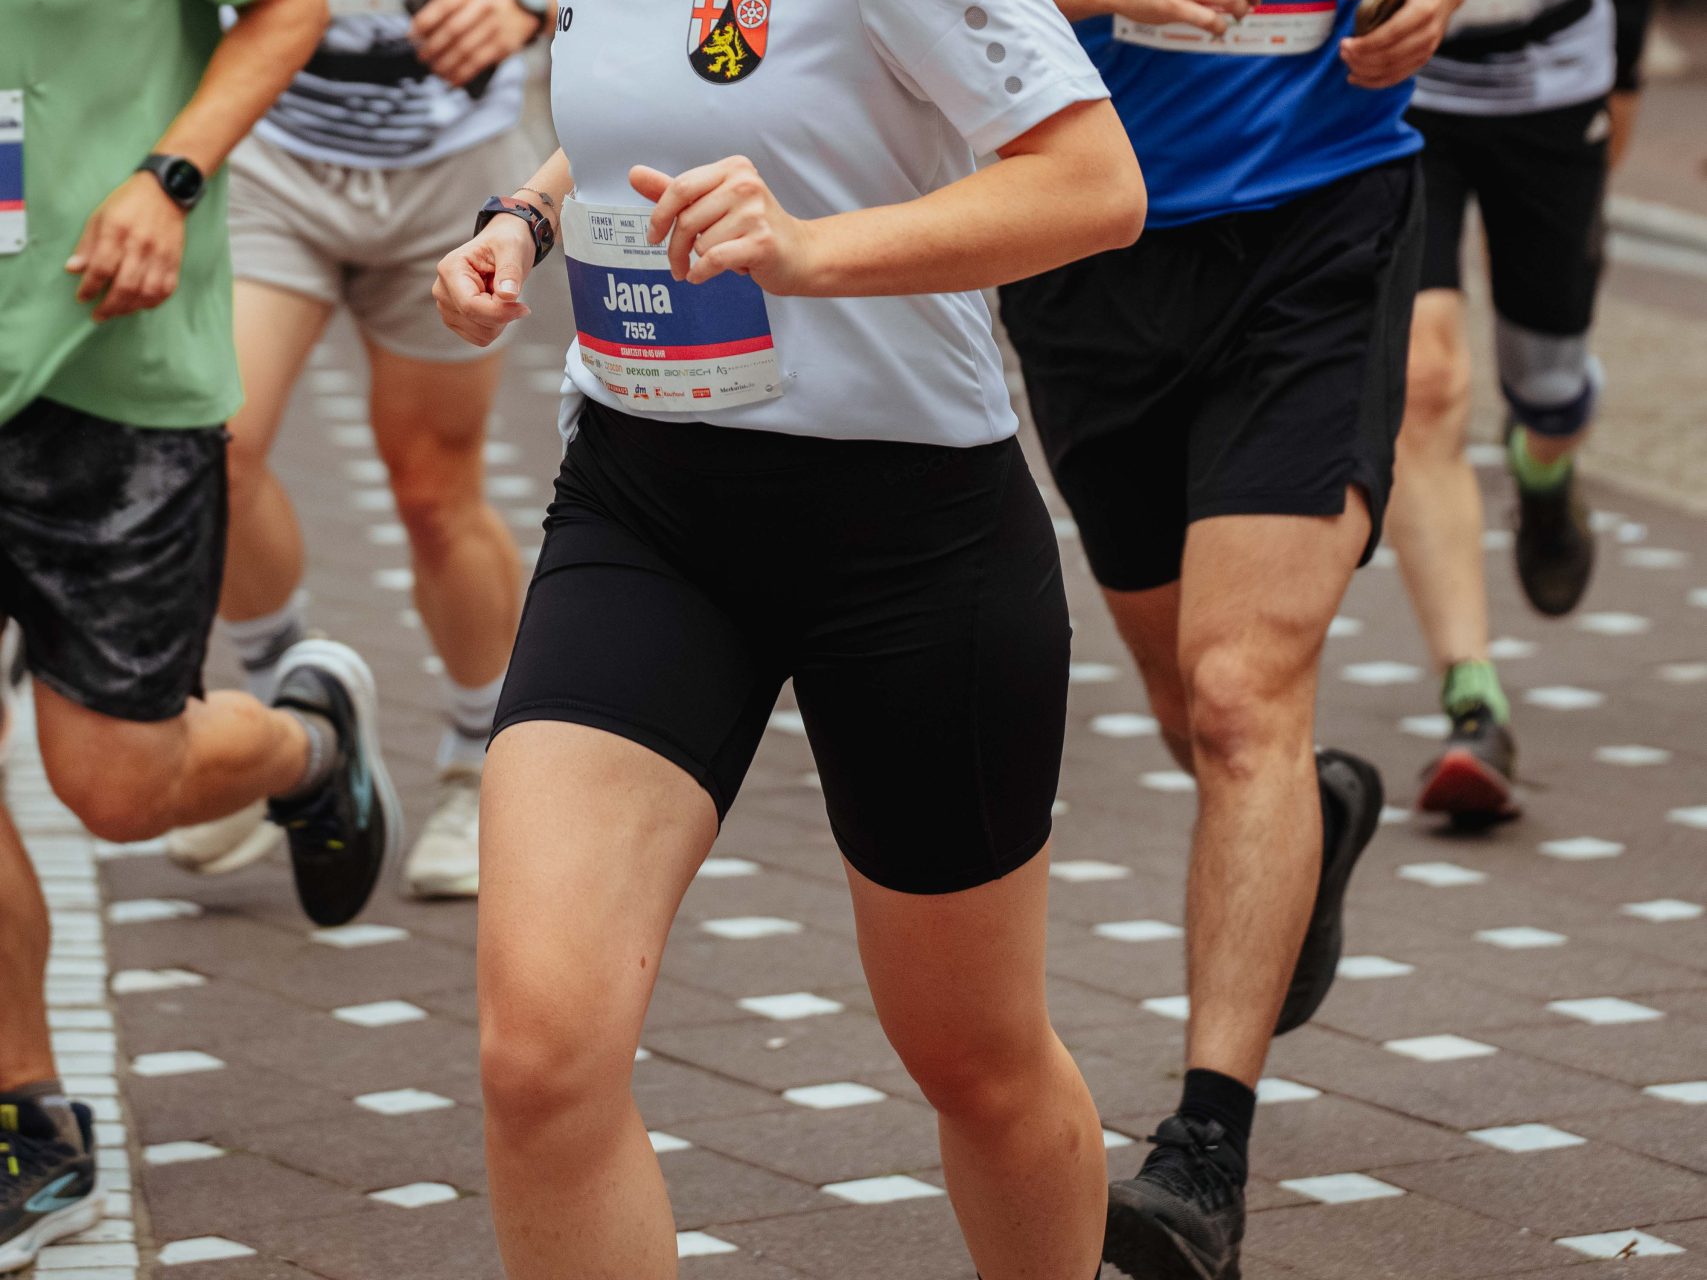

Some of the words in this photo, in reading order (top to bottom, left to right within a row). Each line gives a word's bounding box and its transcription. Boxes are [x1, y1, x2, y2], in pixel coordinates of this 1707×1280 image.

[591, 215, 613, 226] FIRMEN
[620, 220, 635, 228] MAINZ
[592, 227, 613, 241] LAUF
[603, 273, 673, 314] Jana
[622, 321, 657, 340] 7552
[635, 384, 647, 394] dm
